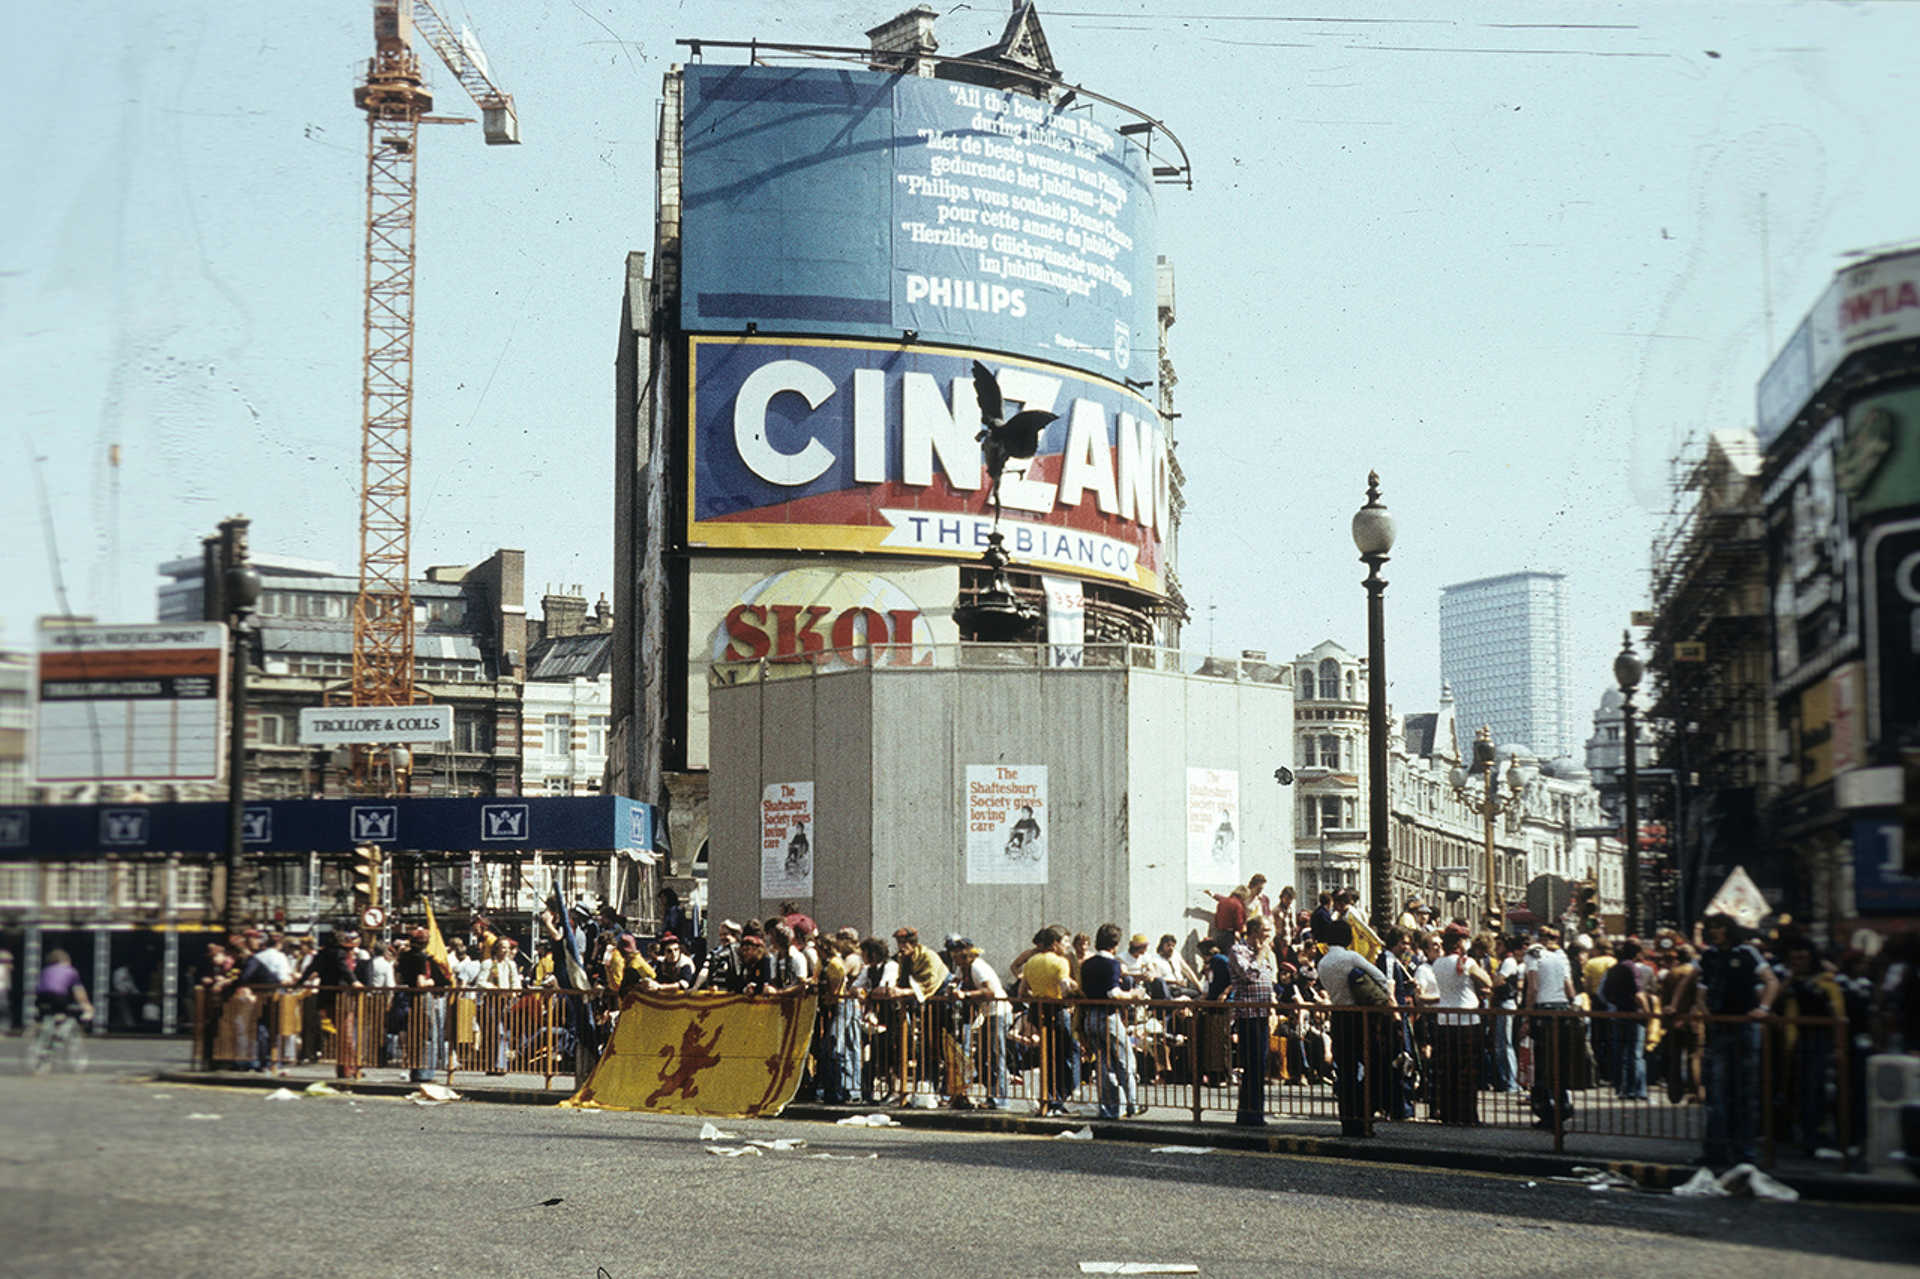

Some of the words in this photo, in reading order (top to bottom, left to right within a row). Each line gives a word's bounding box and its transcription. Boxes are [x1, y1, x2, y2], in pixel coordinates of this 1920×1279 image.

[984, 92, 1010, 115] the
[1014, 98, 1045, 124] best
[972, 112, 1023, 145] during
[961, 135, 982, 156] de
[983, 138, 1025, 164] beste
[931, 156, 1015, 185] gedurende
[1016, 166, 1041, 191] het
[937, 204, 979, 225] pour
[980, 208, 1020, 232] cette
[972, 187, 1009, 208] vous
[1011, 194, 1069, 223] souhaite
[906, 274, 1027, 318] PHILIPS
[734, 358, 1171, 544] CINZANO
[908, 515, 993, 547] THE
[1016, 525, 1131, 573] BIANCO
[725, 603, 934, 668] SKOL
[312, 719, 382, 733] TROLLOPE
[384, 719, 395, 731] &
[397, 718, 440, 731] COLLS
[996, 767, 1018, 780] The
[969, 781, 1038, 798] Shaftesbury
[969, 795, 1011, 810] Society
[1013, 796, 1043, 810] gives
[969, 808, 1006, 823] loving
[969, 822, 995, 832] care
